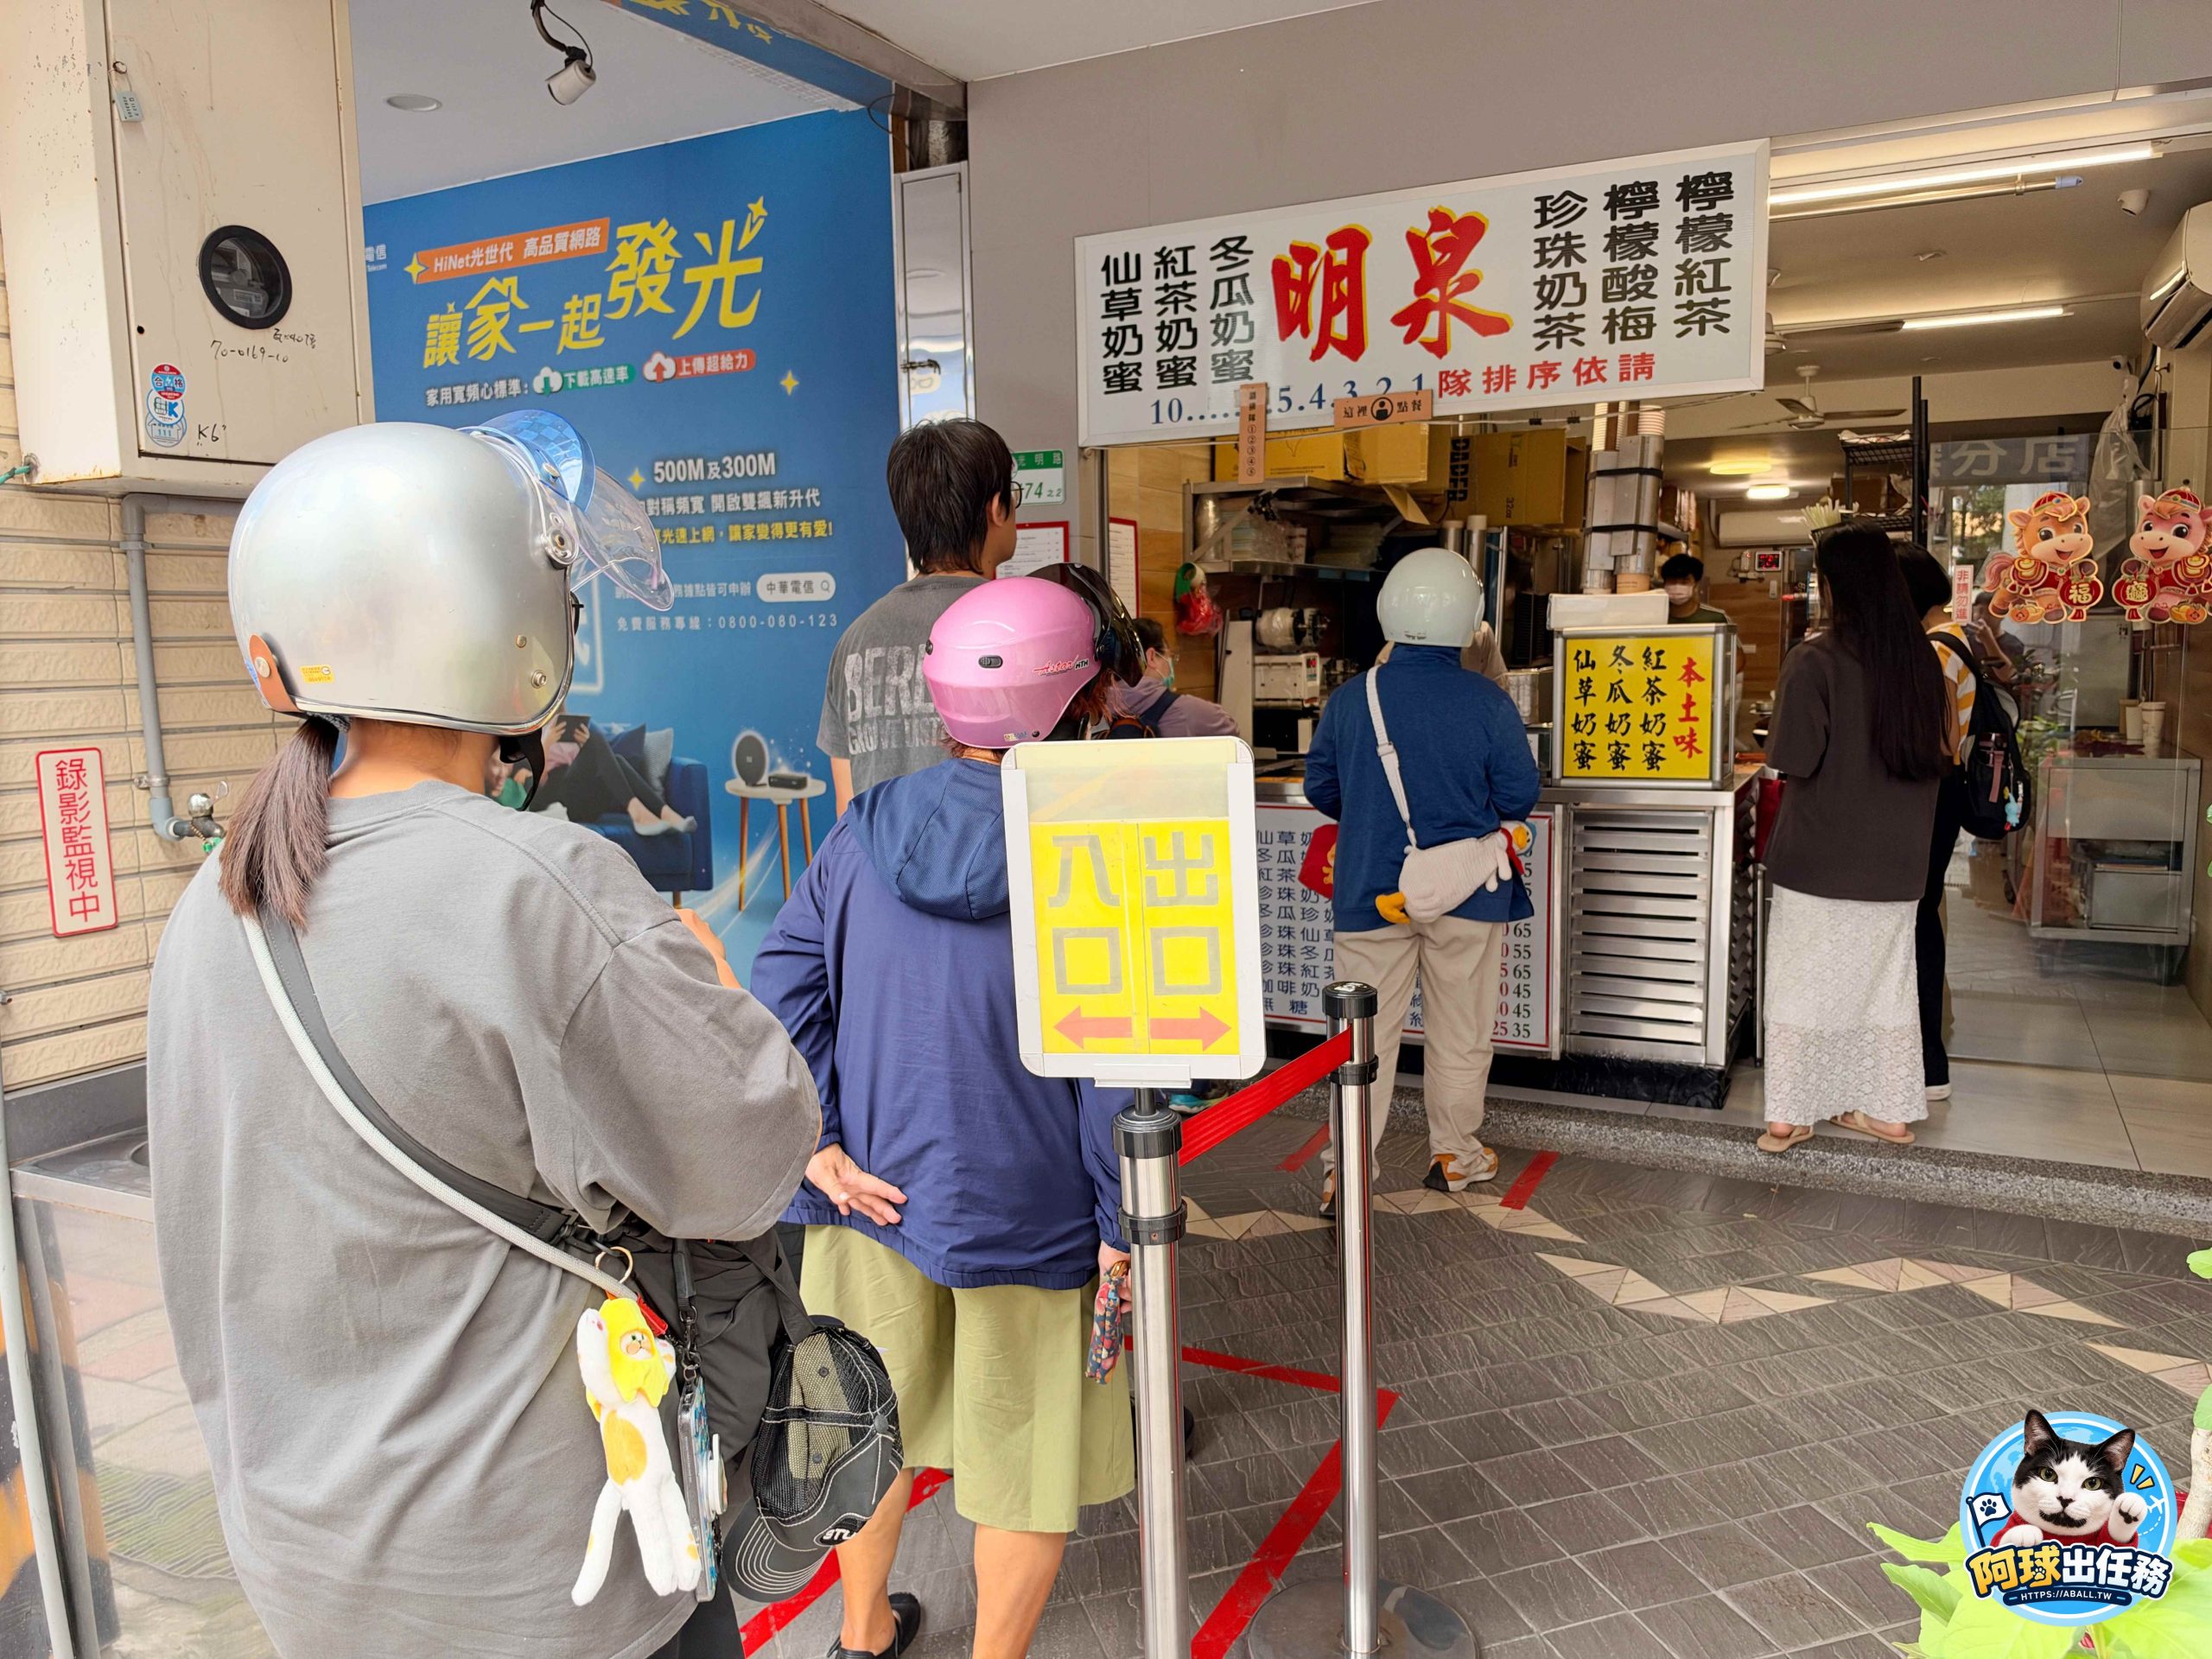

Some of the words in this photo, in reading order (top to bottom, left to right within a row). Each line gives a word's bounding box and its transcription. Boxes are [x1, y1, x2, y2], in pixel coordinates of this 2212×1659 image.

[423, 212, 768, 369] 讓家一起發光
[433, 242, 514, 273] HiNet光世代
[523, 226, 601, 258] 高品質網路
[1209, 235, 1254, 385] 冬瓜奶蜜
[1271, 204, 1514, 363] 明泉
[1532, 190, 1588, 352] 珍珠奶茶
[1602, 181, 1660, 344] 檸檬酸梅
[1675, 171, 1734, 339] 檸檬紅茶
[1100, 251, 1143, 395] 仙草奶蜜
[1154, 245, 1198, 390] 紅茶奶蜜
[1396, 399, 1421, 413] 點餐
[653, 453, 776, 483] 500M及300M
[766, 580, 814, 595] 中華電信
[2069, 583, 2092, 603] 福
[1571, 649, 1597, 770] 仙草奶蜜
[1605, 645, 1634, 771] 冬瓜奶蜜
[1640, 645, 1668, 771] 紅茶奶蜜
[1673, 657, 1705, 759] 本土味
[54, 758, 101, 923] 錄影監視中
[1143, 831, 1222, 995] 出口
[1513, 922, 1532, 938] 65
[1513, 944, 1532, 960] 55
[1513, 963, 1532, 980] 65
[1512, 982, 1532, 1000] 45
[1512, 1002, 1532, 1020] 45
[1512, 1021, 1531, 1039] 35
